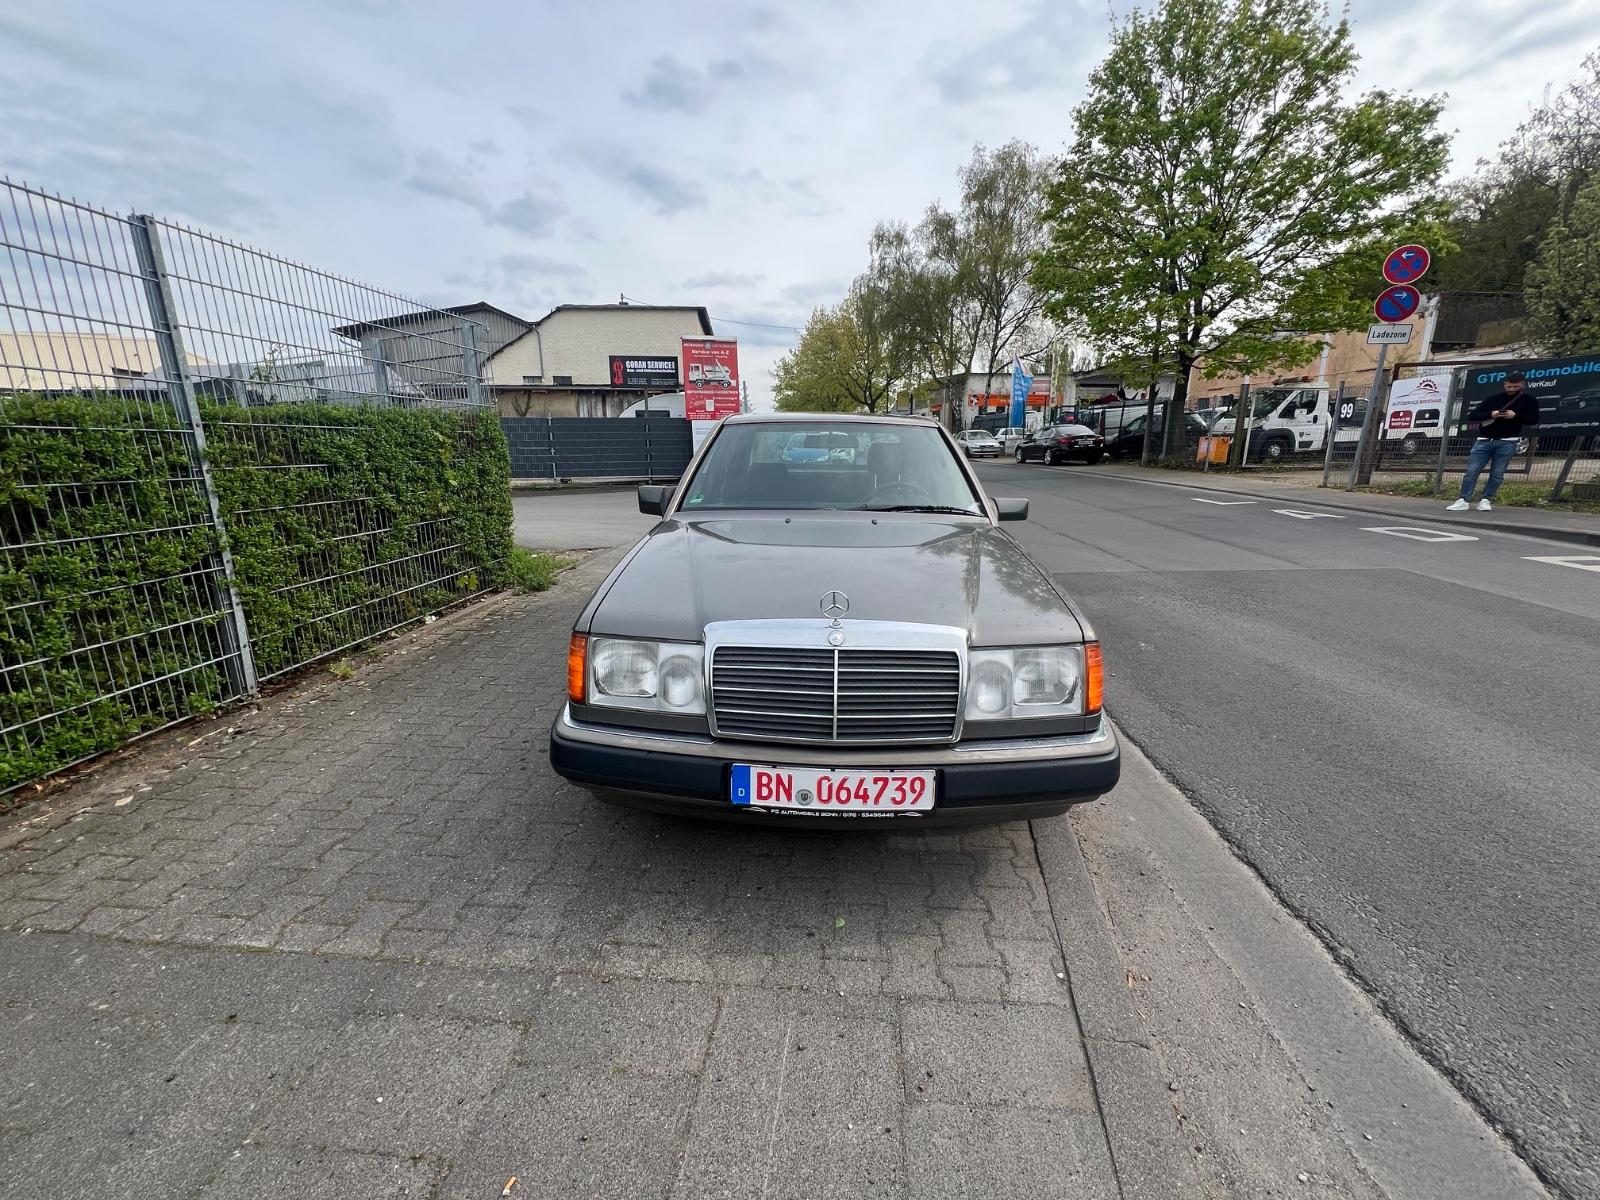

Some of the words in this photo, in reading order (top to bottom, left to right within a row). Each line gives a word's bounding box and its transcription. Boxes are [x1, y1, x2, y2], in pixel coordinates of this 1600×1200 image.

[1371, 330, 1407, 339] Ladezone
[647, 361, 672, 369] SERVICE
[1477, 372, 1507, 384] GTP
[1512, 362, 1600, 379] utomobile
[1340, 403, 1354, 418] 99
[738, 787, 745, 797] D
[756, 771, 793, 802] BN
[816, 775, 926, 806] 064739
[780, 809, 819, 817] AUTOMOBILE
